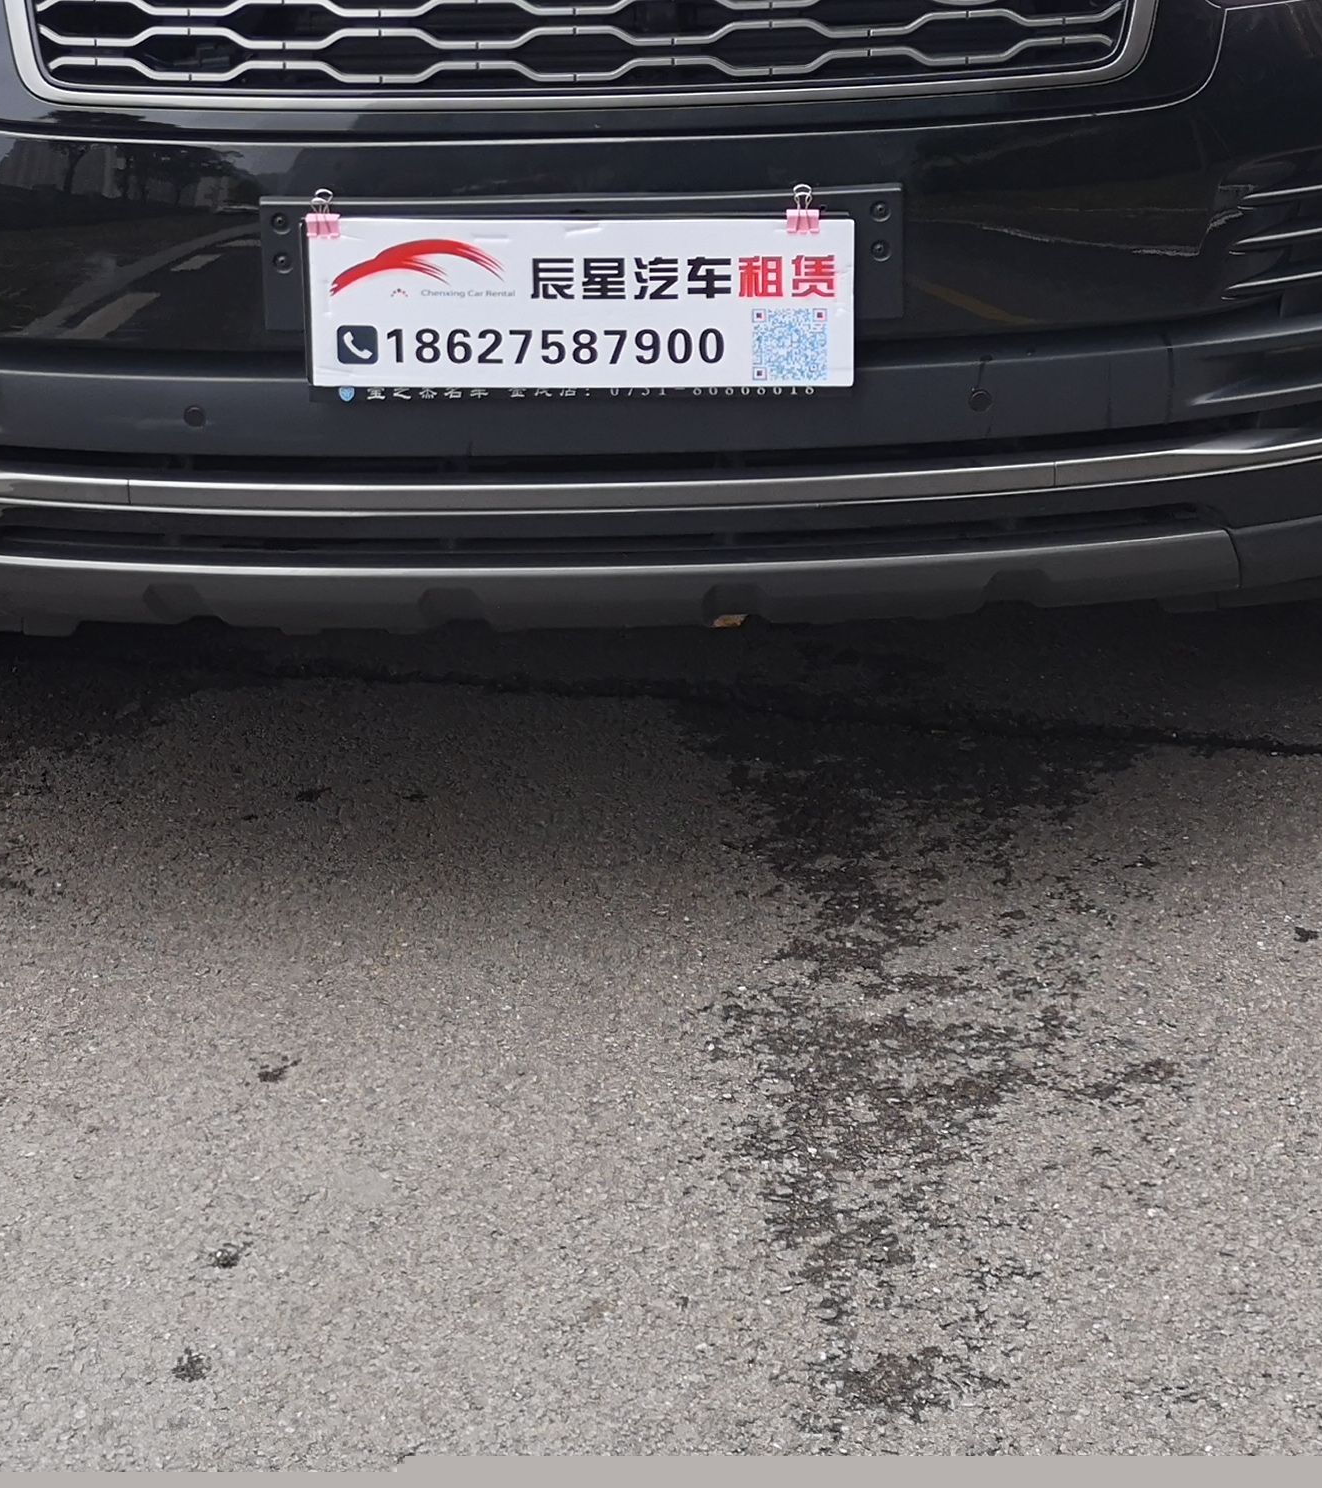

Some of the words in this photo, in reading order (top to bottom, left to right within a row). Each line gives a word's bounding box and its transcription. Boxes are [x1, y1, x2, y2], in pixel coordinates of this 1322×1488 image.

[420, 289, 466, 299] Chenxing
[467, 289, 482, 298] Car
[485, 289, 516, 298] Rental
[530, 254, 836, 300] 辰星汽车租赁
[386, 328, 726, 365] 18627587900
